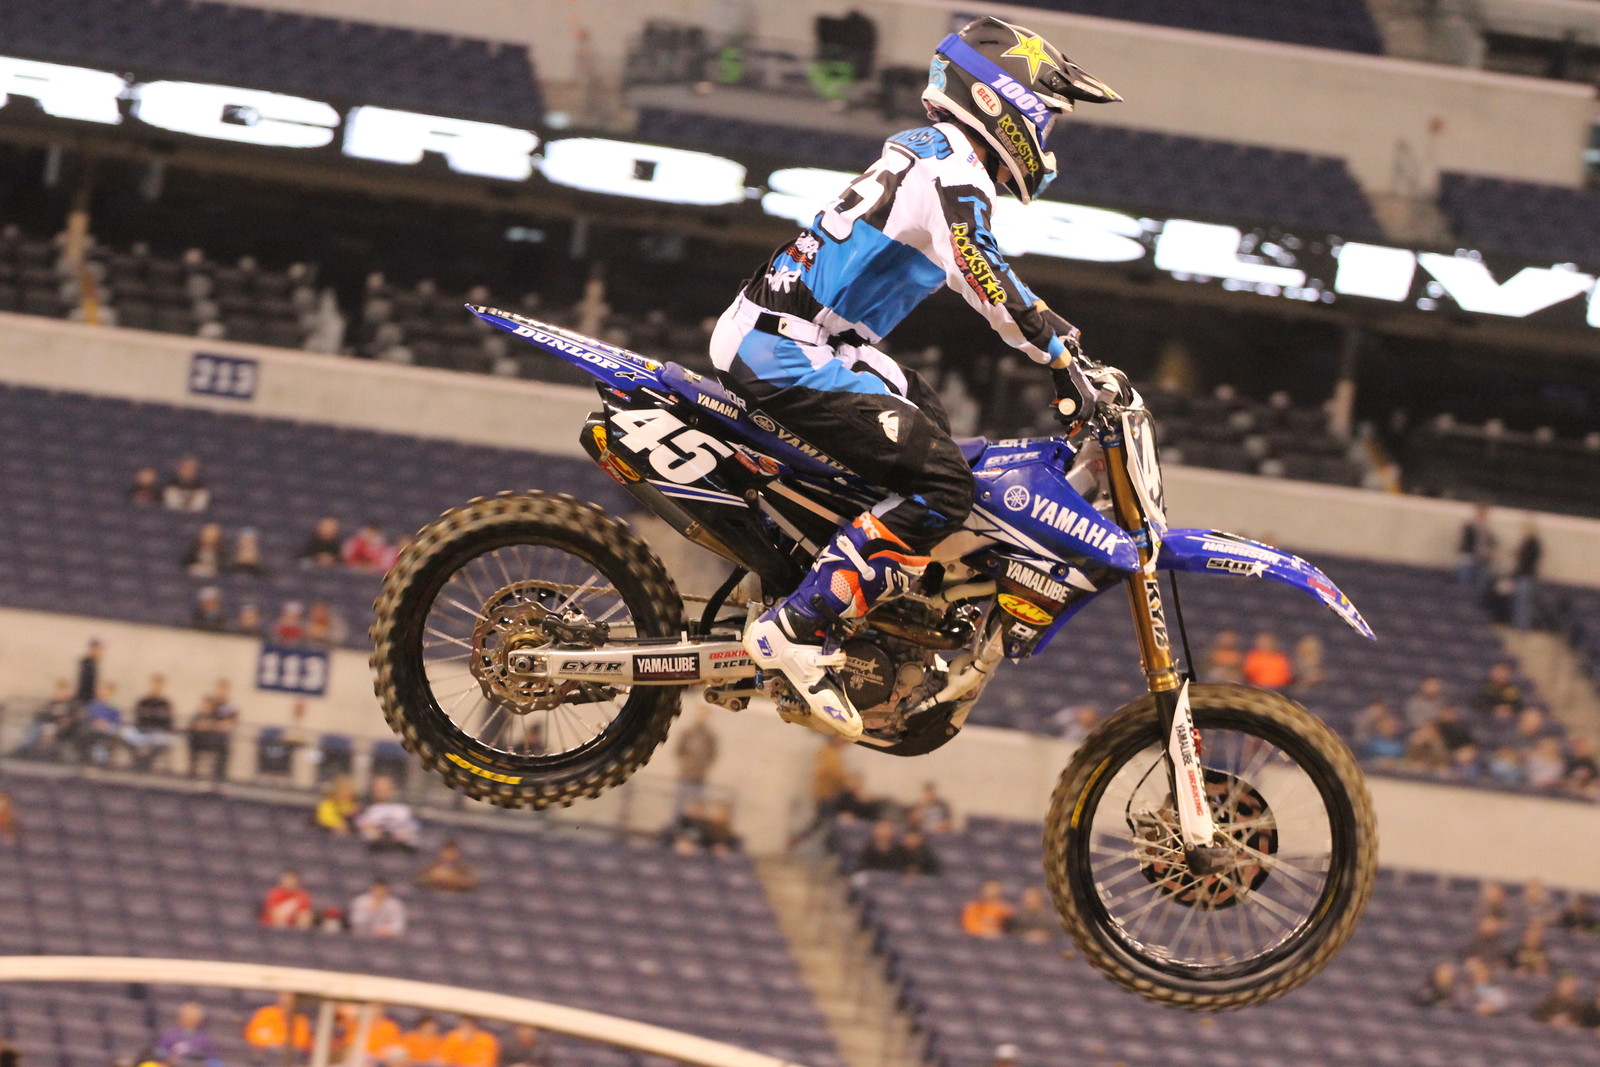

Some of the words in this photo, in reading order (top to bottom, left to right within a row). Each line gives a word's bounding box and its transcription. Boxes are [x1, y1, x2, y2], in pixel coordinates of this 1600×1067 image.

[976, 87, 996, 112] BELL
[989, 73, 1050, 123] 100%
[951, 223, 1008, 307] ROCKSTAR
[512, 325, 621, 370] DUNLOP
[697, 392, 740, 420] YAMAHA
[610, 408, 735, 484] 45
[1030, 494, 1119, 556] YAMAHA
[1202, 541, 1281, 565] HARRISON
[1006, 560, 1070, 603] YAMALUBE
[1143, 579, 1170, 650] KYB
[260, 652, 326, 692] 113
[560, 660, 623, 674] GYTR
[636, 656, 697, 674] YAMALUBE
[709, 650, 750, 660] BRAKIN
[713, 659, 755, 669] EXCEL
[1175, 723, 1194, 767] YAMALUBE
[1187, 769, 1204, 817] BRAKING
